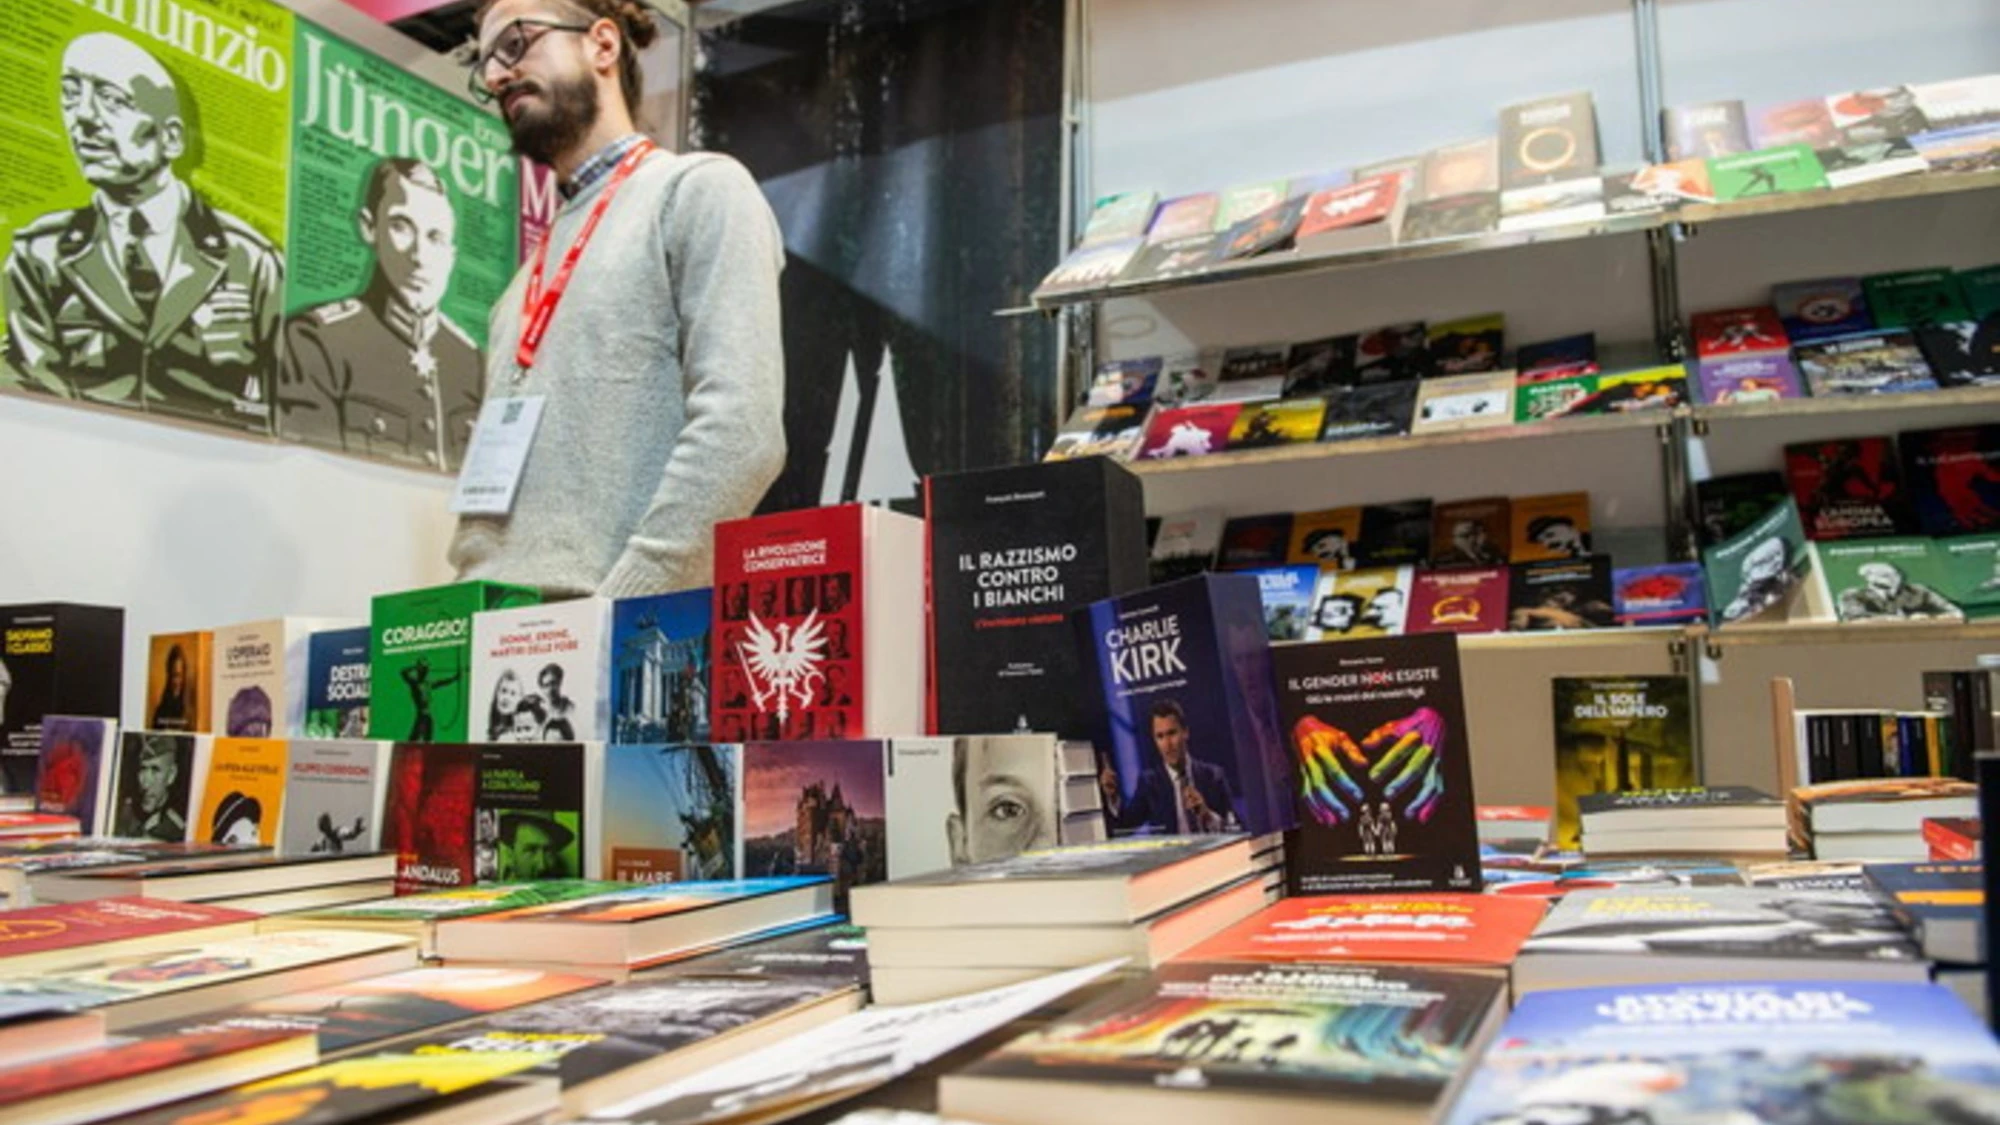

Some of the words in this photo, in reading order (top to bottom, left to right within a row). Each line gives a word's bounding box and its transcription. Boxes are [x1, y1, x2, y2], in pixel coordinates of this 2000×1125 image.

[72, 0, 286, 92] nunzio
[742, 548, 756, 559] LA
[758, 538, 827, 557] RIVOLUZIONE
[959, 553, 976, 572] IL
[979, 543, 1077, 570] RAZZISMO
[743, 552, 827, 573] CONSERVATRICE
[976, 565, 1059, 588] CONTRO
[973, 590, 980, 609] I
[984, 583, 1065, 608] BIANCHI
[382, 617, 470, 645] CORAGGIO!
[1105, 614, 1180, 649] CHARLIE
[1110, 636, 1188, 685] KIRK
[1288, 678, 1301, 690] IL
[1302, 674, 1358, 690] GENDER
[1360, 670, 1394, 688] NON
[1396, 667, 1439, 683] ESISTE
[1593, 693, 1606, 704] IL
[1610, 692, 1647, 705] SOLE
[1574, 704, 1669, 719] DELL'IMPERO
